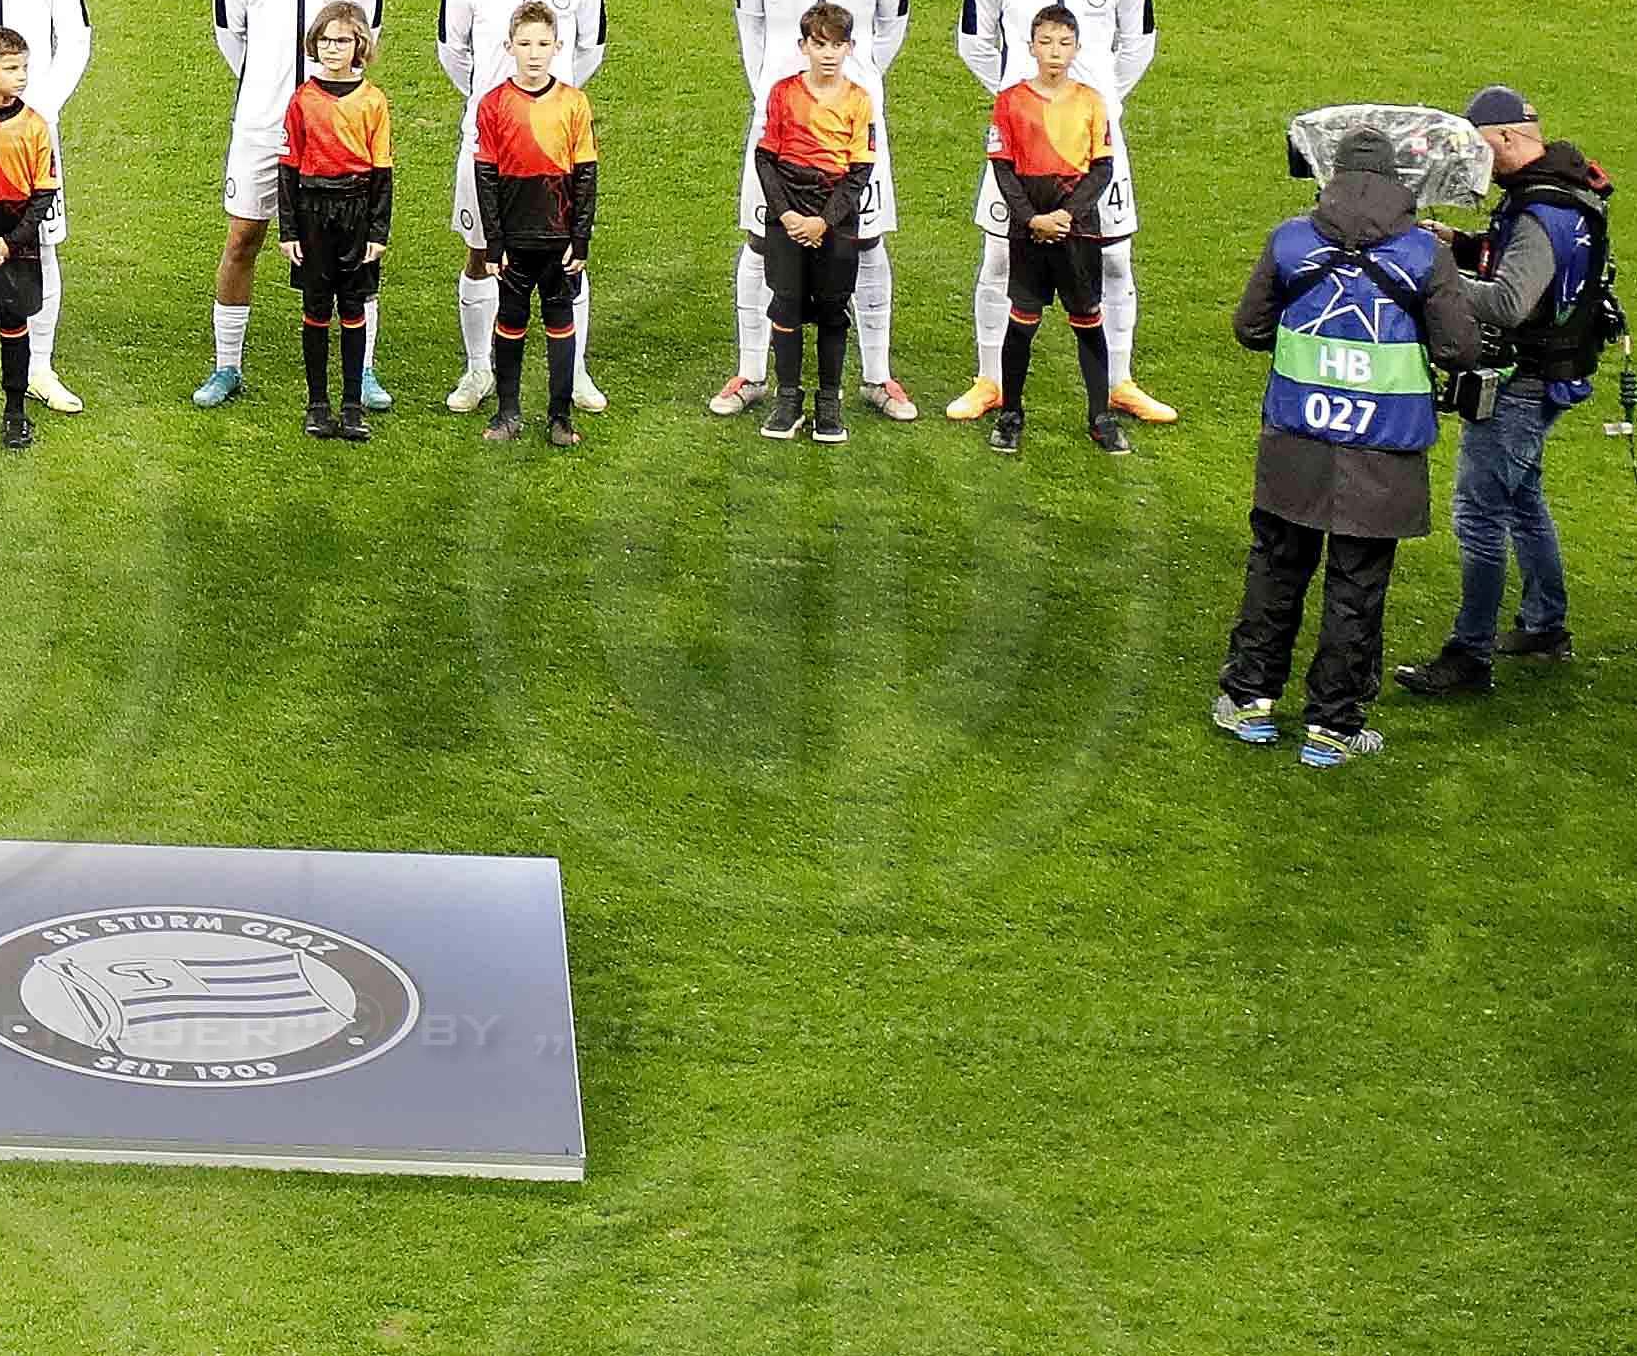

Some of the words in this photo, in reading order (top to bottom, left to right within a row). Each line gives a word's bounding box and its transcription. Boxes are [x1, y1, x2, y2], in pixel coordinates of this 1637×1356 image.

[858, 180, 882, 215] 21
[1108, 177, 1130, 212] 47
[1319, 346, 1371, 383] HB
[1304, 393, 1378, 435] 027
[41, 924, 90, 946] SK
[97, 914, 223, 933] STURM
[240, 921, 339, 956] GRAZ
[93, 1055, 173, 1078] SEIT
[193, 1061, 278, 1080] 1909
